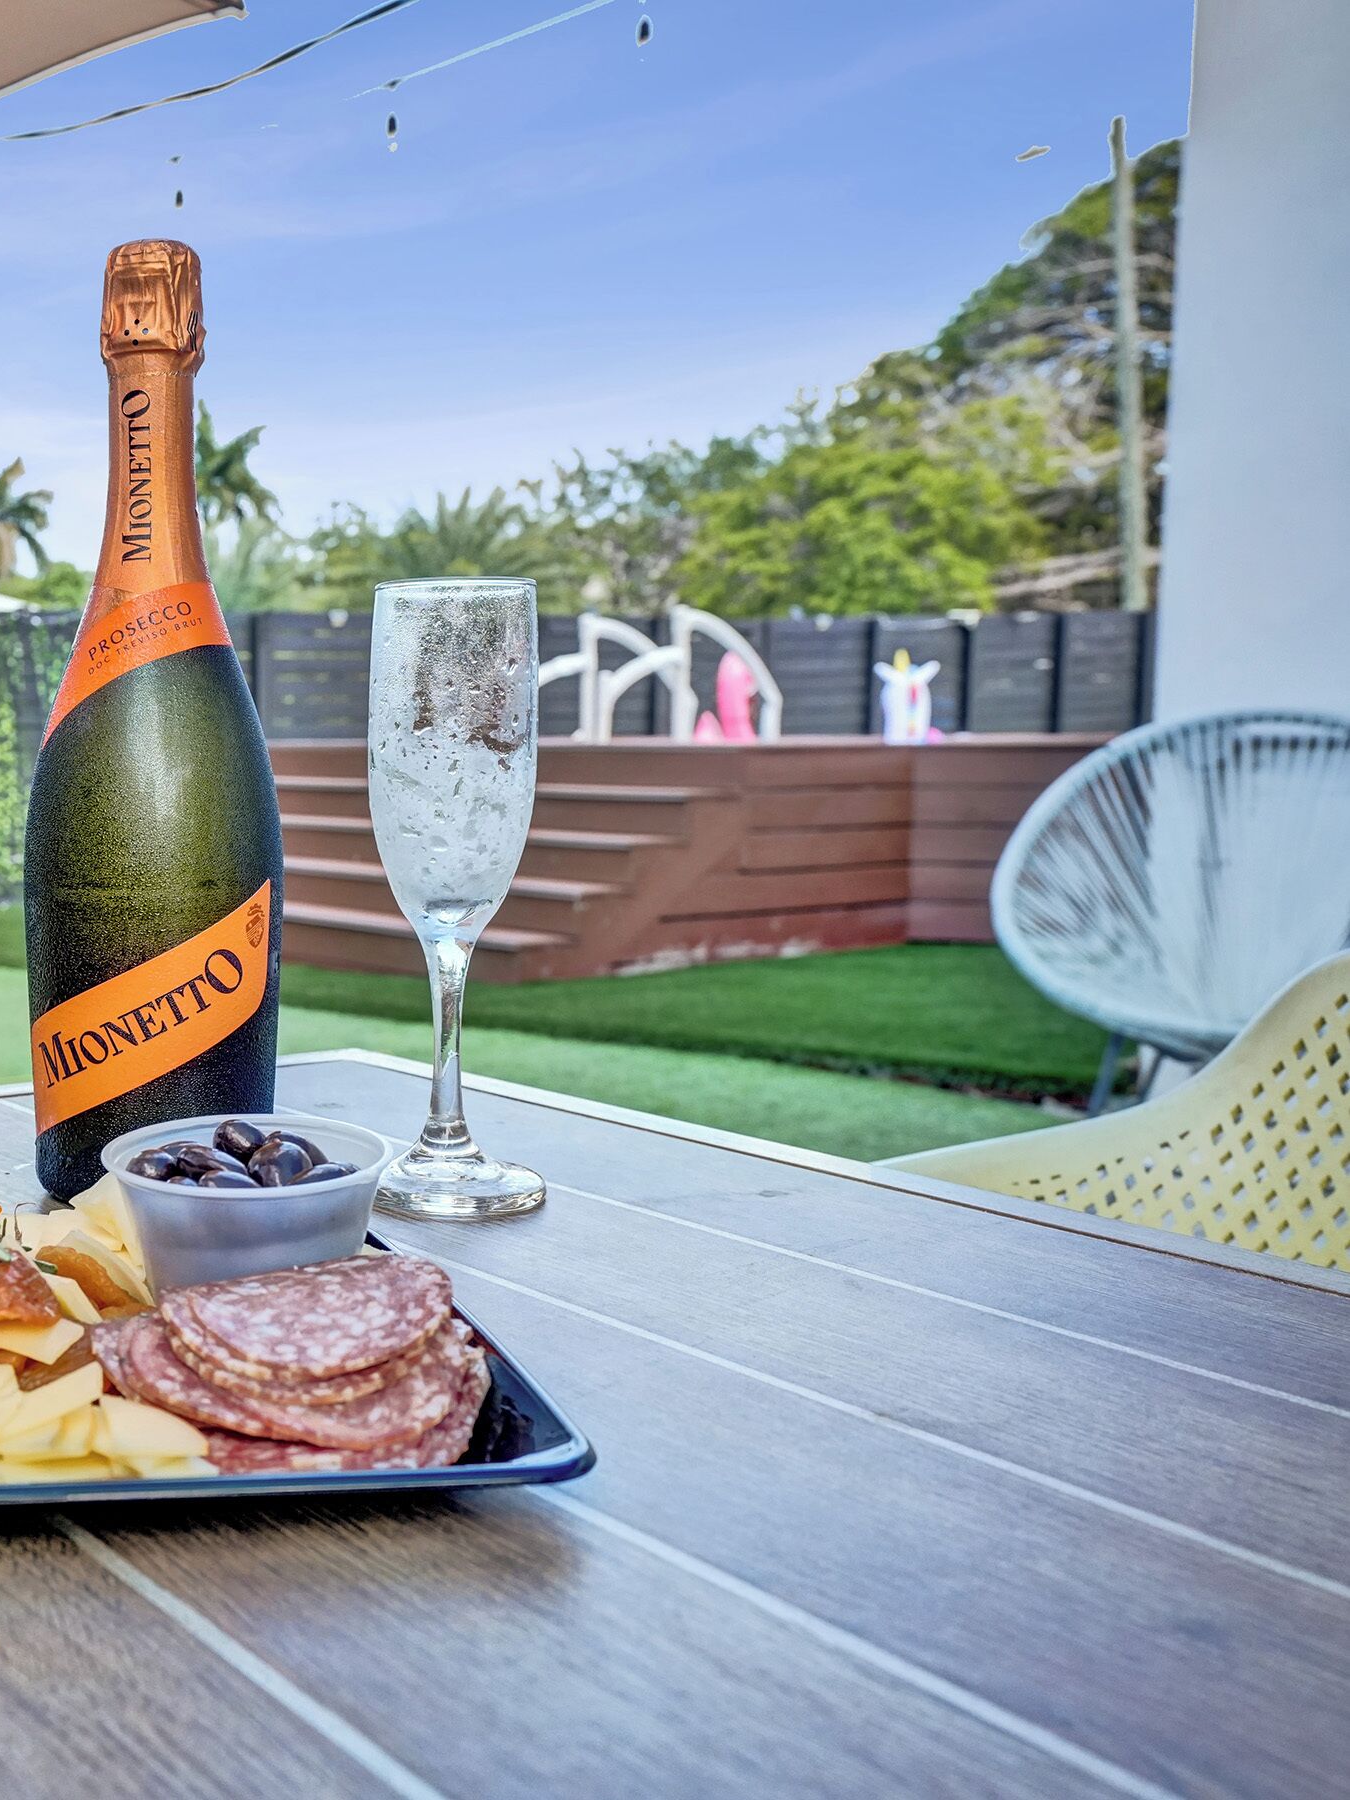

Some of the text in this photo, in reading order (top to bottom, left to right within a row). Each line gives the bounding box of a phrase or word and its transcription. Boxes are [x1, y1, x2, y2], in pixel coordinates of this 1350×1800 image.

[121, 389, 152, 566] MIONETTO
[88, 601, 191, 661] PROSECCO
[88, 617, 203, 675] DOC TREVISO BRUT
[38, 949, 243, 1088] MIONETTO
